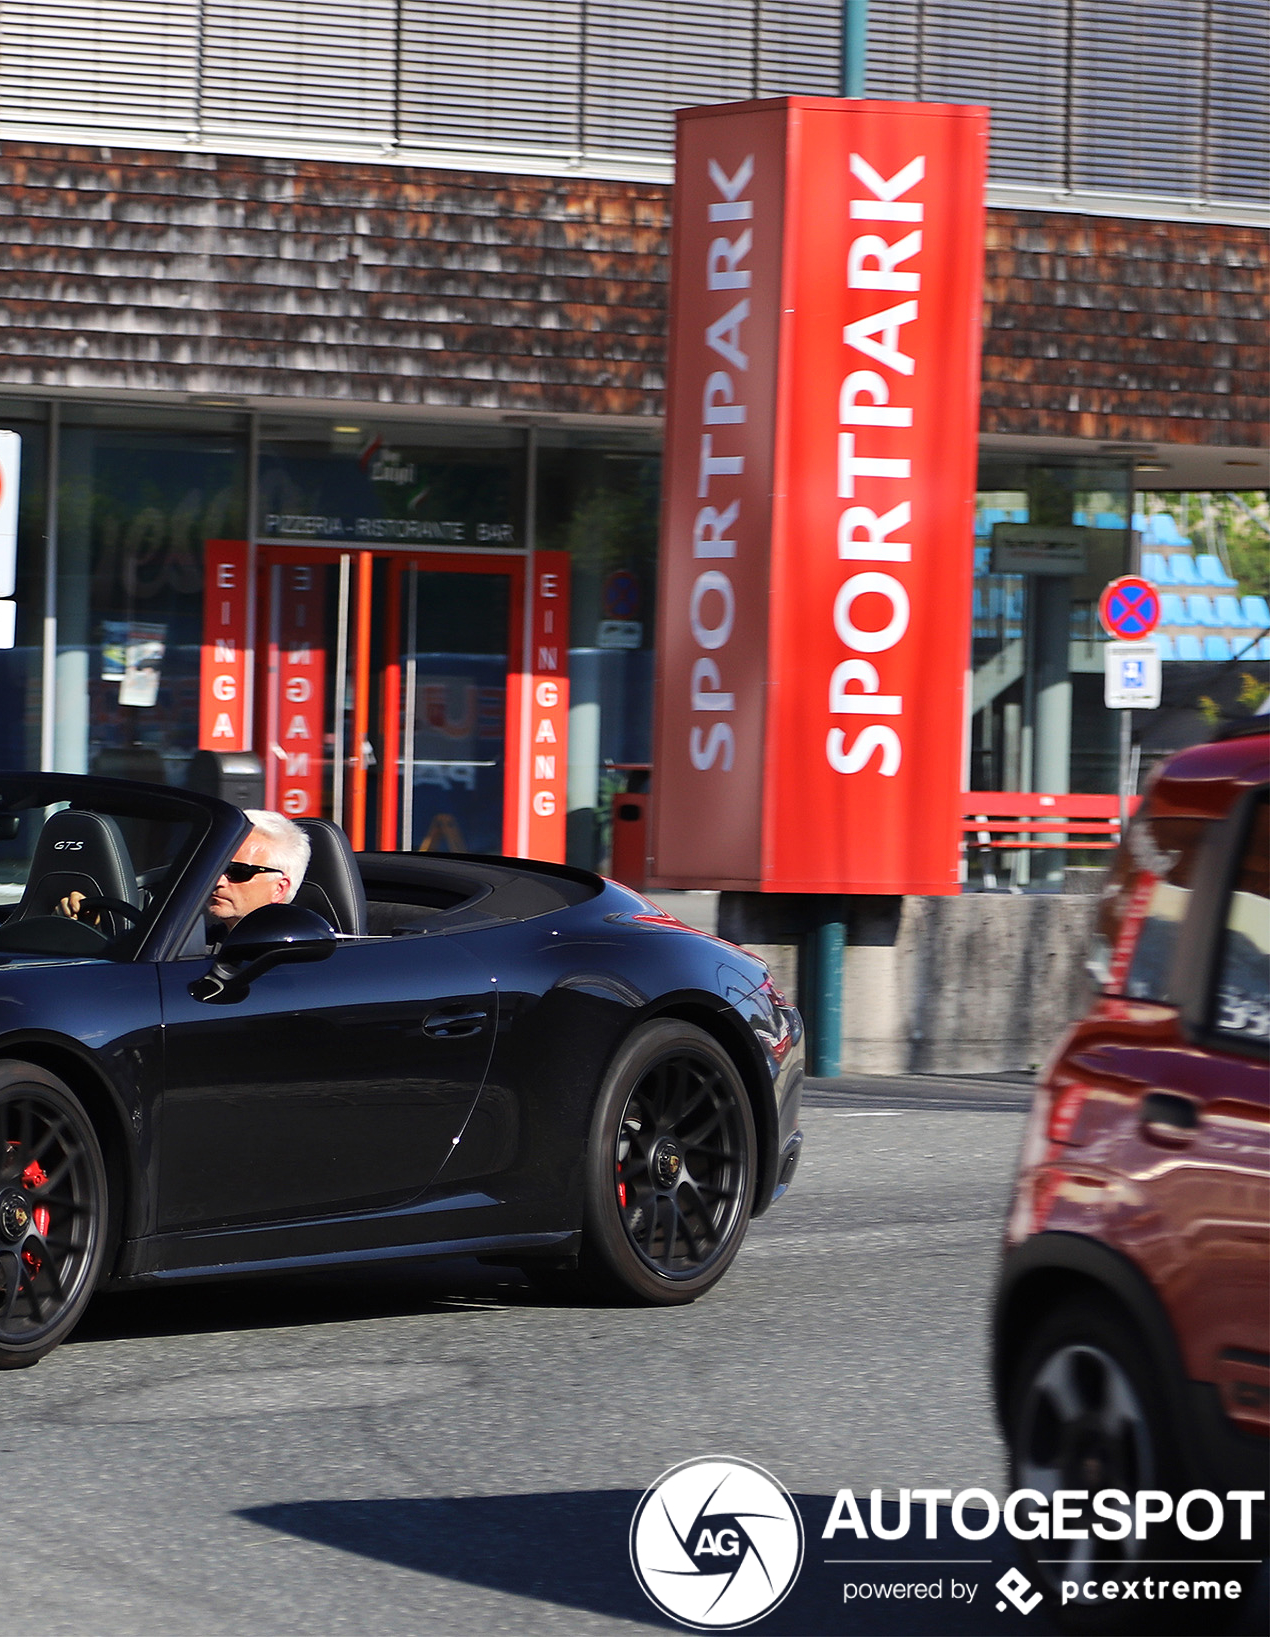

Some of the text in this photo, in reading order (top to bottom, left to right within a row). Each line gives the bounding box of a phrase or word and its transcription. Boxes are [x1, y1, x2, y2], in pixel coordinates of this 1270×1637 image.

[265, 514, 343, 536] PIZZERIA
[355, 518, 465, 540] RISTORANTE
[476, 522, 515, 542] BAR
[689, 154, 755, 772] SPORTPARK
[826, 152, 926, 777] SPORTPARK
[212, 563, 236, 739] EINGA
[533, 574, 559, 817] EINGANG
[53, 841, 84, 851] GTS
